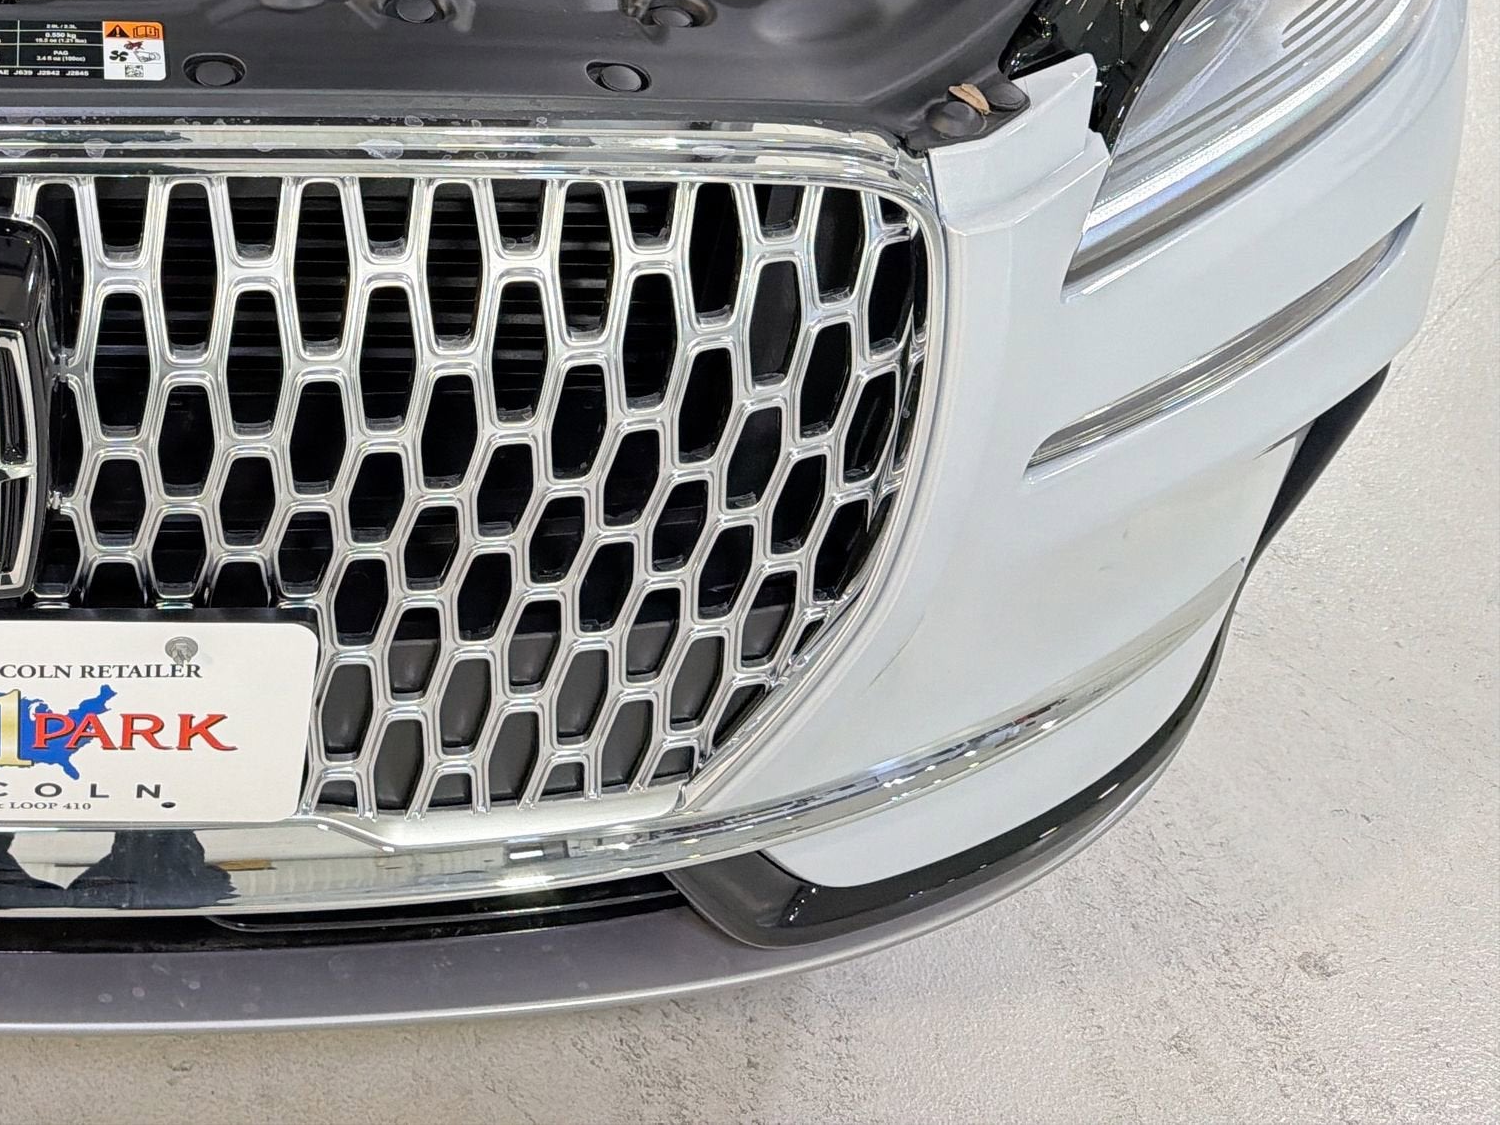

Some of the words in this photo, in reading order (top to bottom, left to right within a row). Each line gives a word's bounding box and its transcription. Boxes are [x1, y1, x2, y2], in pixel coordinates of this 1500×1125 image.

[80, 663, 203, 679] RETAILER
[32, 712, 238, 752] PARK
[10, 801, 59, 811] LOOP
[63, 801, 92, 811] 410
